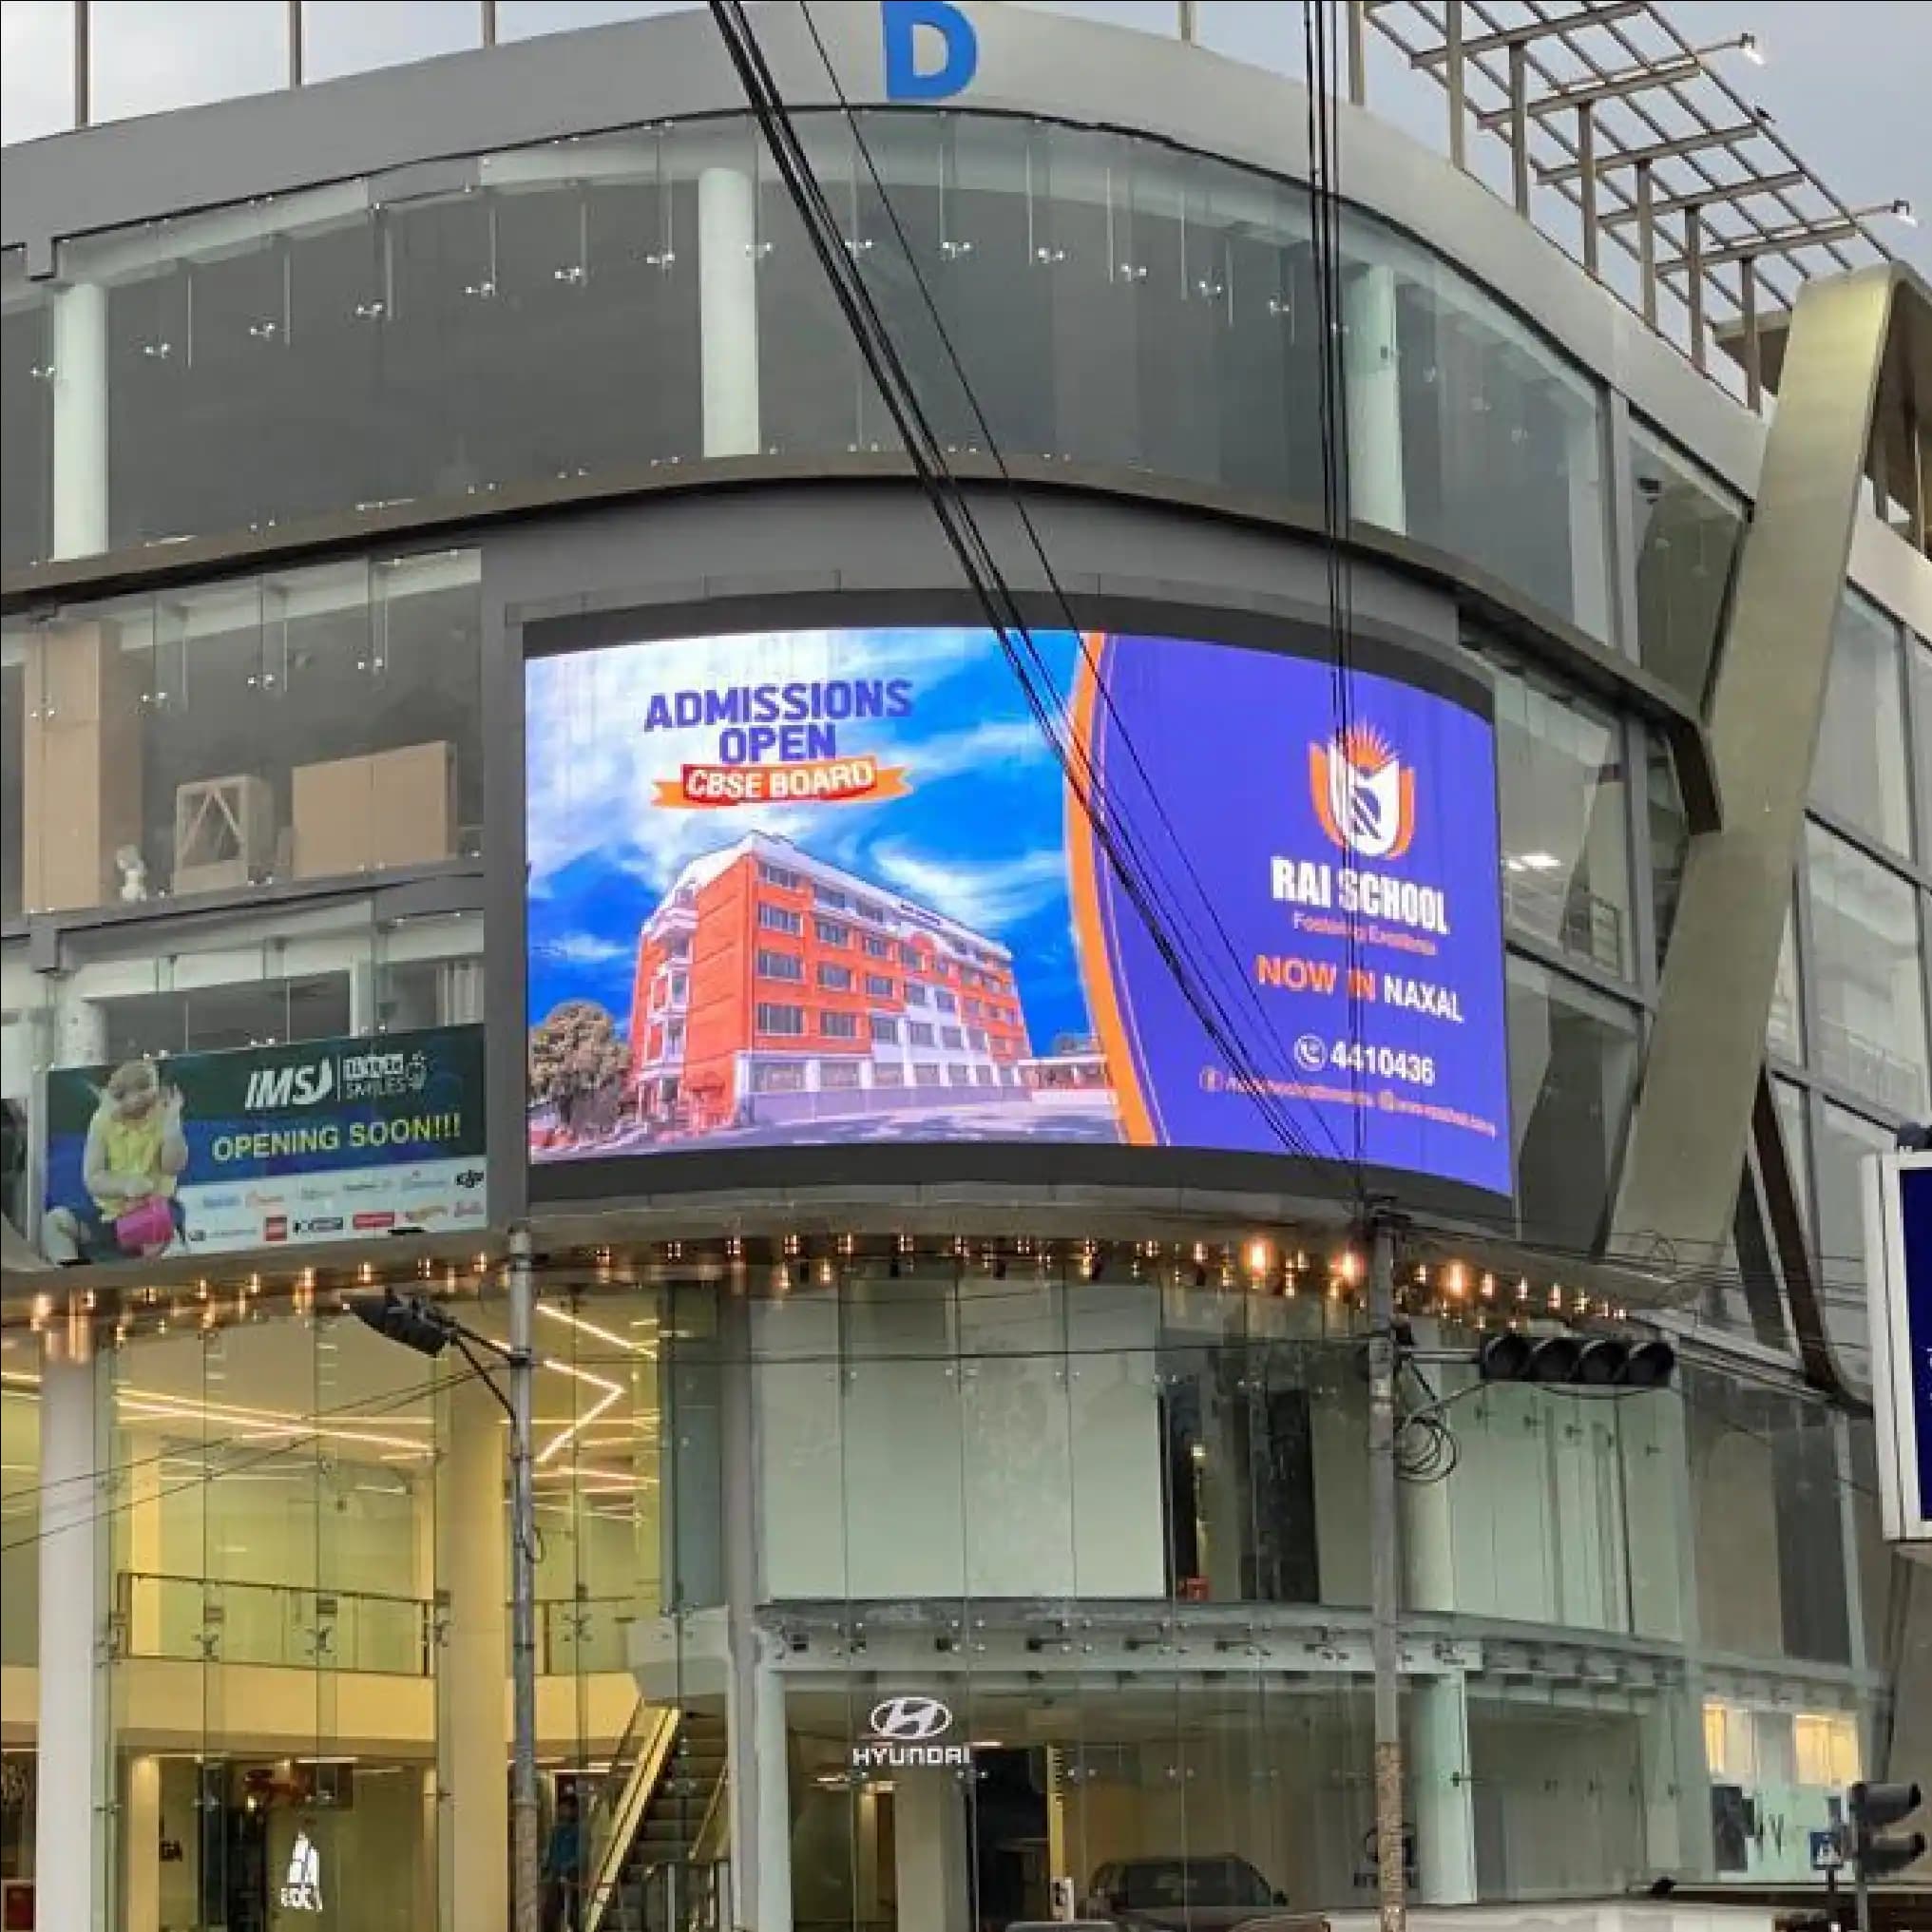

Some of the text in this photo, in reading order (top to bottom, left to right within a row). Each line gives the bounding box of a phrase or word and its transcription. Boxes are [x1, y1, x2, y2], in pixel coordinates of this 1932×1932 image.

[882, 1, 977, 101] D
[644, 679, 913, 732] ADMISSIONS
[719, 722, 836, 763] OPEN
[685, 759, 873, 798] CBSE BOARD
[1270, 855, 1331, 908] RAI
[1337, 868, 1450, 934] SCHOOL
[1256, 954, 1464, 1023] NOW IN NAXAL
[212, 1112, 461, 1161] OPENING SOON!!!
[852, 1747, 971, 1767] HYUNDAI
